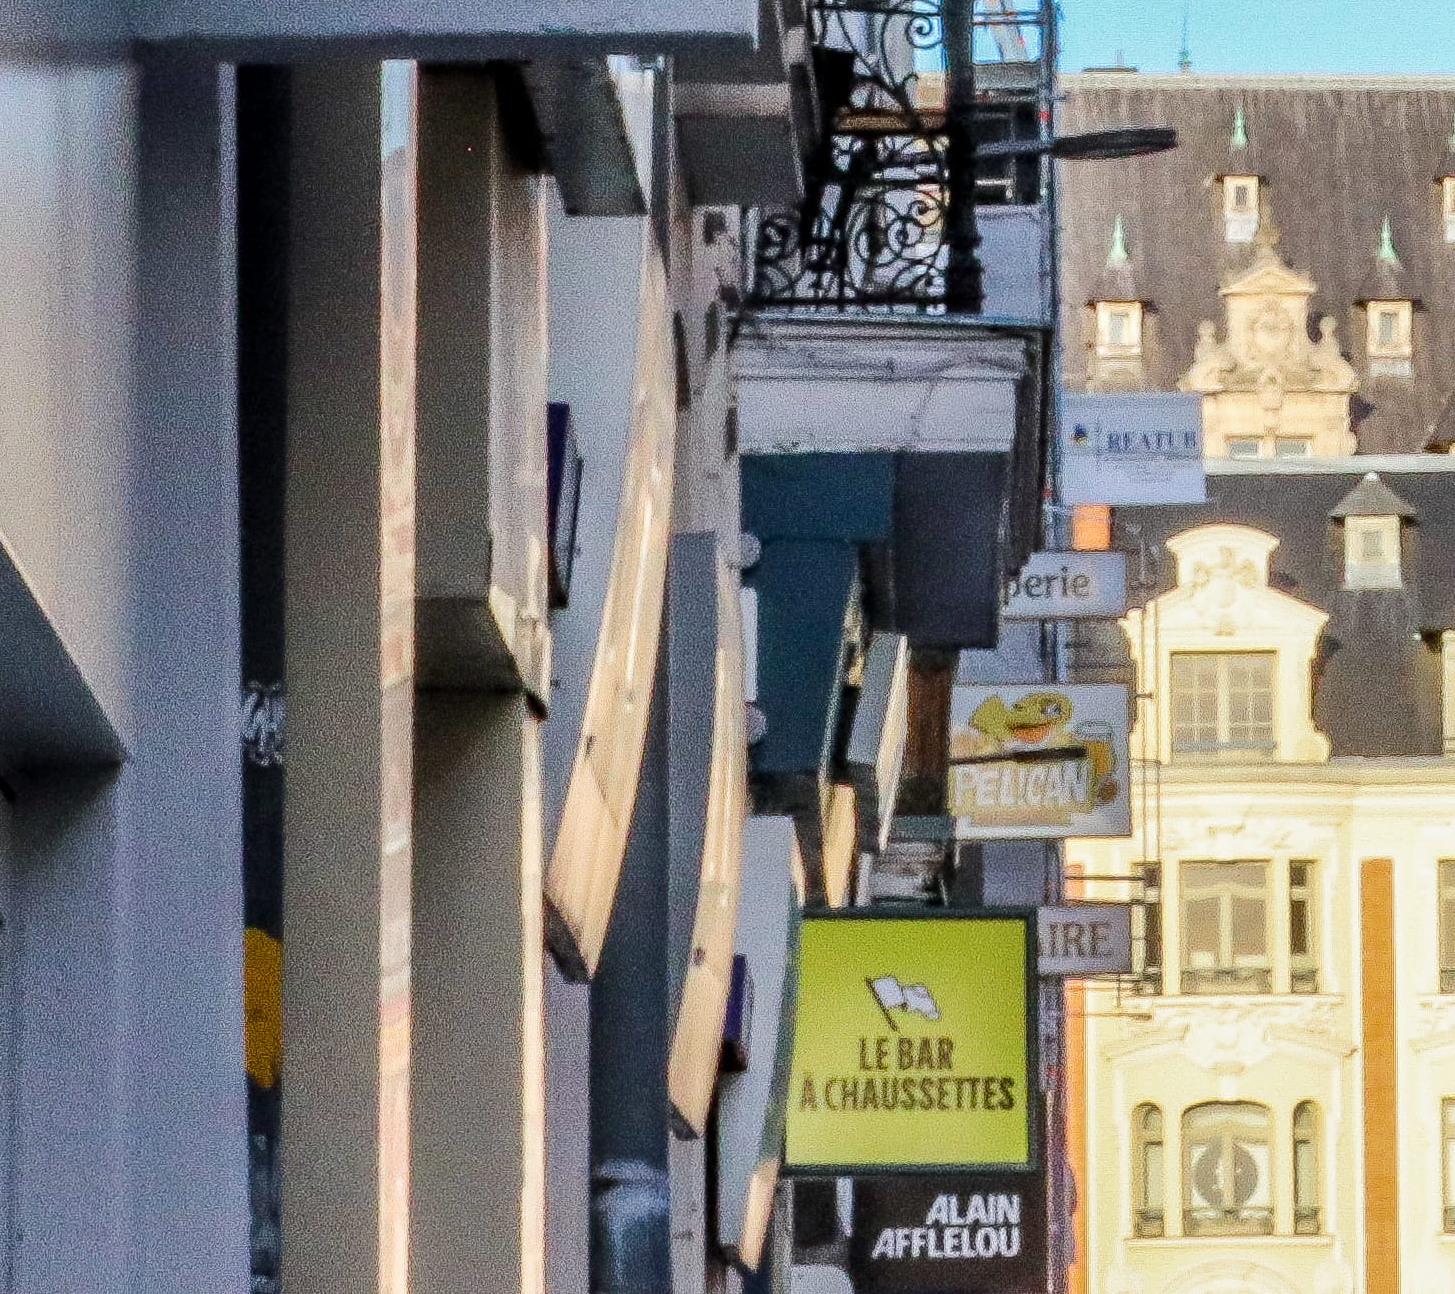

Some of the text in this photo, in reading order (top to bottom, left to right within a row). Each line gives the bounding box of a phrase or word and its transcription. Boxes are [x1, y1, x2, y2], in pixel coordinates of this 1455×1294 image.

[954, 760, 1089, 807] PELICAN
[1038, 920, 1114, 958] IRE
[859, 1037, 953, 1070] LE BAR
[824, 1076, 1016, 1111] CHAUSSETTES
[926, 1193, 1021, 1225] ALAIN
[872, 1226, 1021, 1259] AFFLELOU
